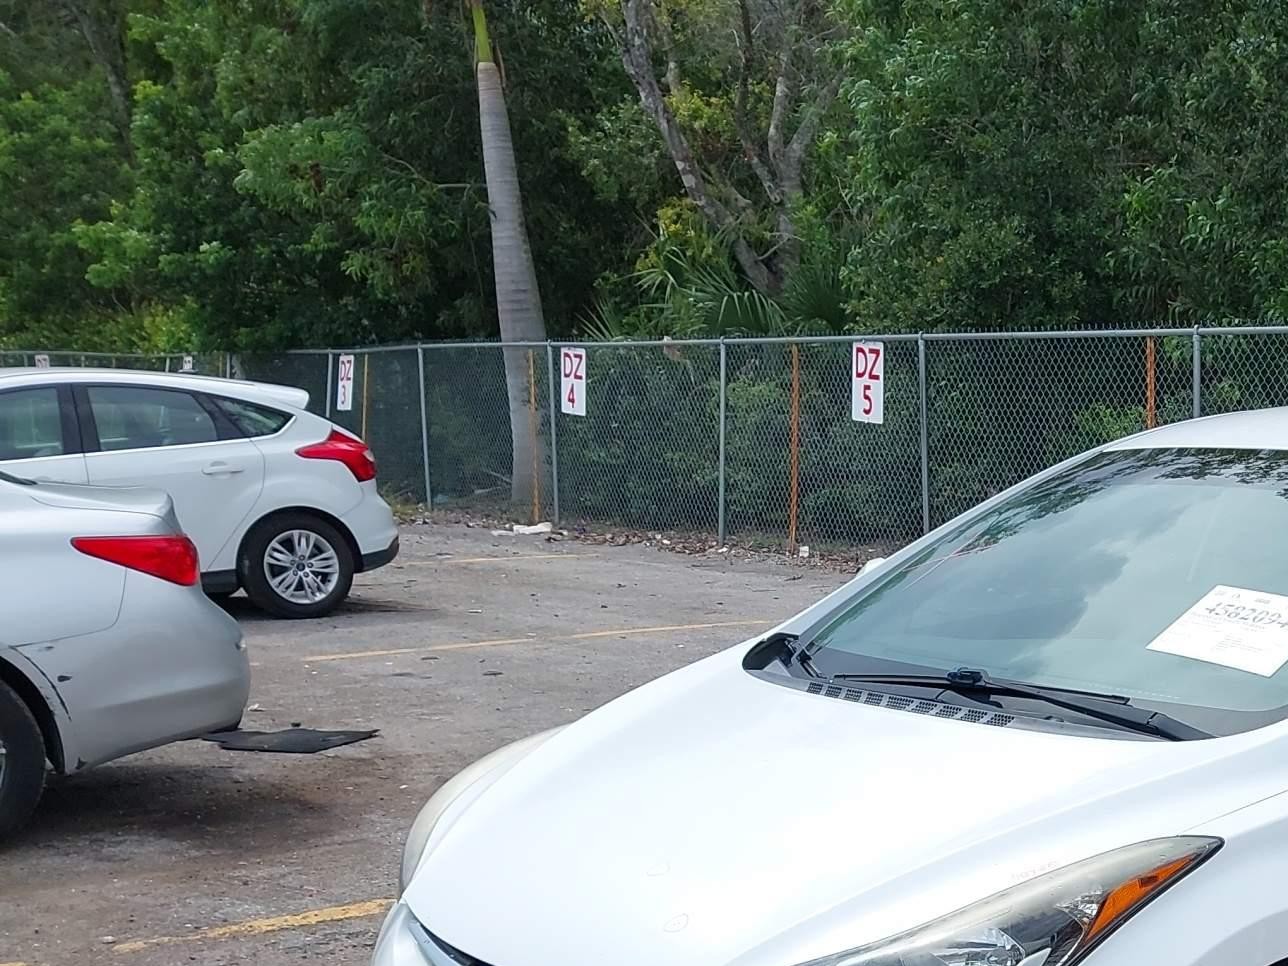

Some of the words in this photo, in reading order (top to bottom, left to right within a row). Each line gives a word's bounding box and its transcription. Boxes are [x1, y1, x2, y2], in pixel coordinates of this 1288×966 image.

[340, 359, 352, 381] DZ
[563, 352, 583, 381] DZ
[855, 346, 881, 381] DZ
[567, 383, 576, 409] 4
[862, 384, 873, 416] 5
